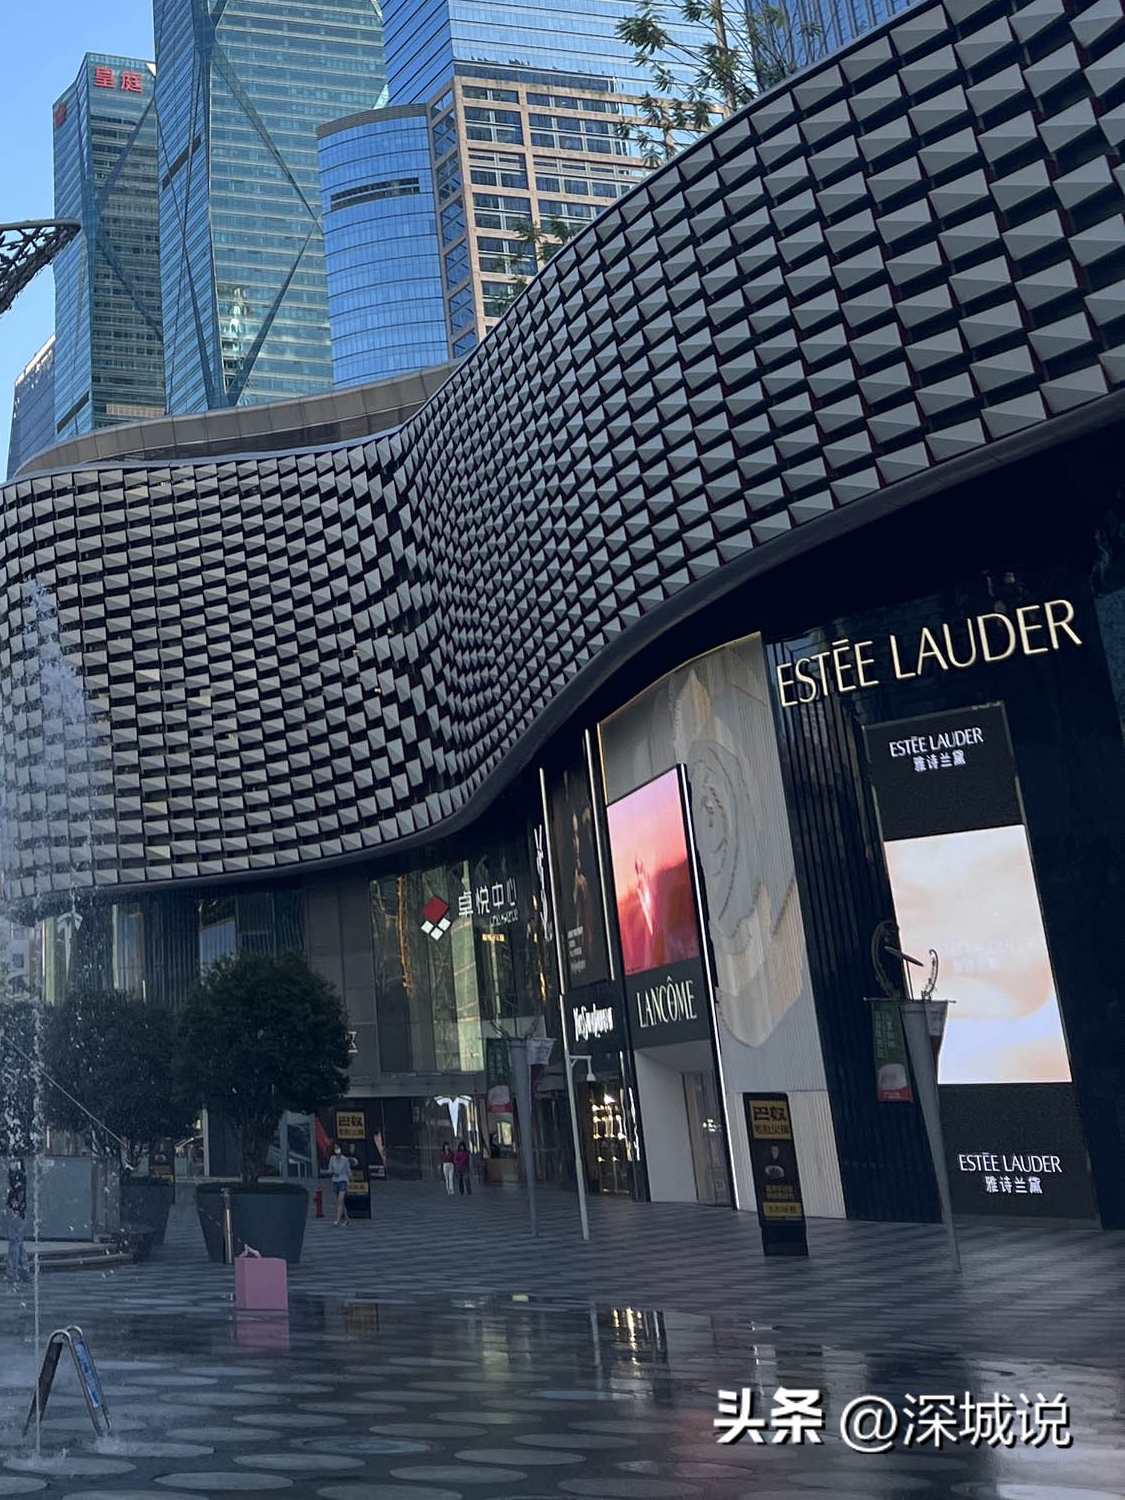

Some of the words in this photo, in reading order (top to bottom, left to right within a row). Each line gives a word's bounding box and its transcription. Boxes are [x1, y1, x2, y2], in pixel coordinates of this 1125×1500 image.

[94, 67, 143, 93] 皇庭
[890, 599, 1082, 680] LAUDER
[928, 727, 984, 751] LAUDER
[458, 877, 517, 917] 卓悦中心
[636, 975, 697, 1028] LANCÔME
[1002, 1154, 1063, 1173] LAUDER
[985, 1176, 1043, 1194] 雅诗兰黛
